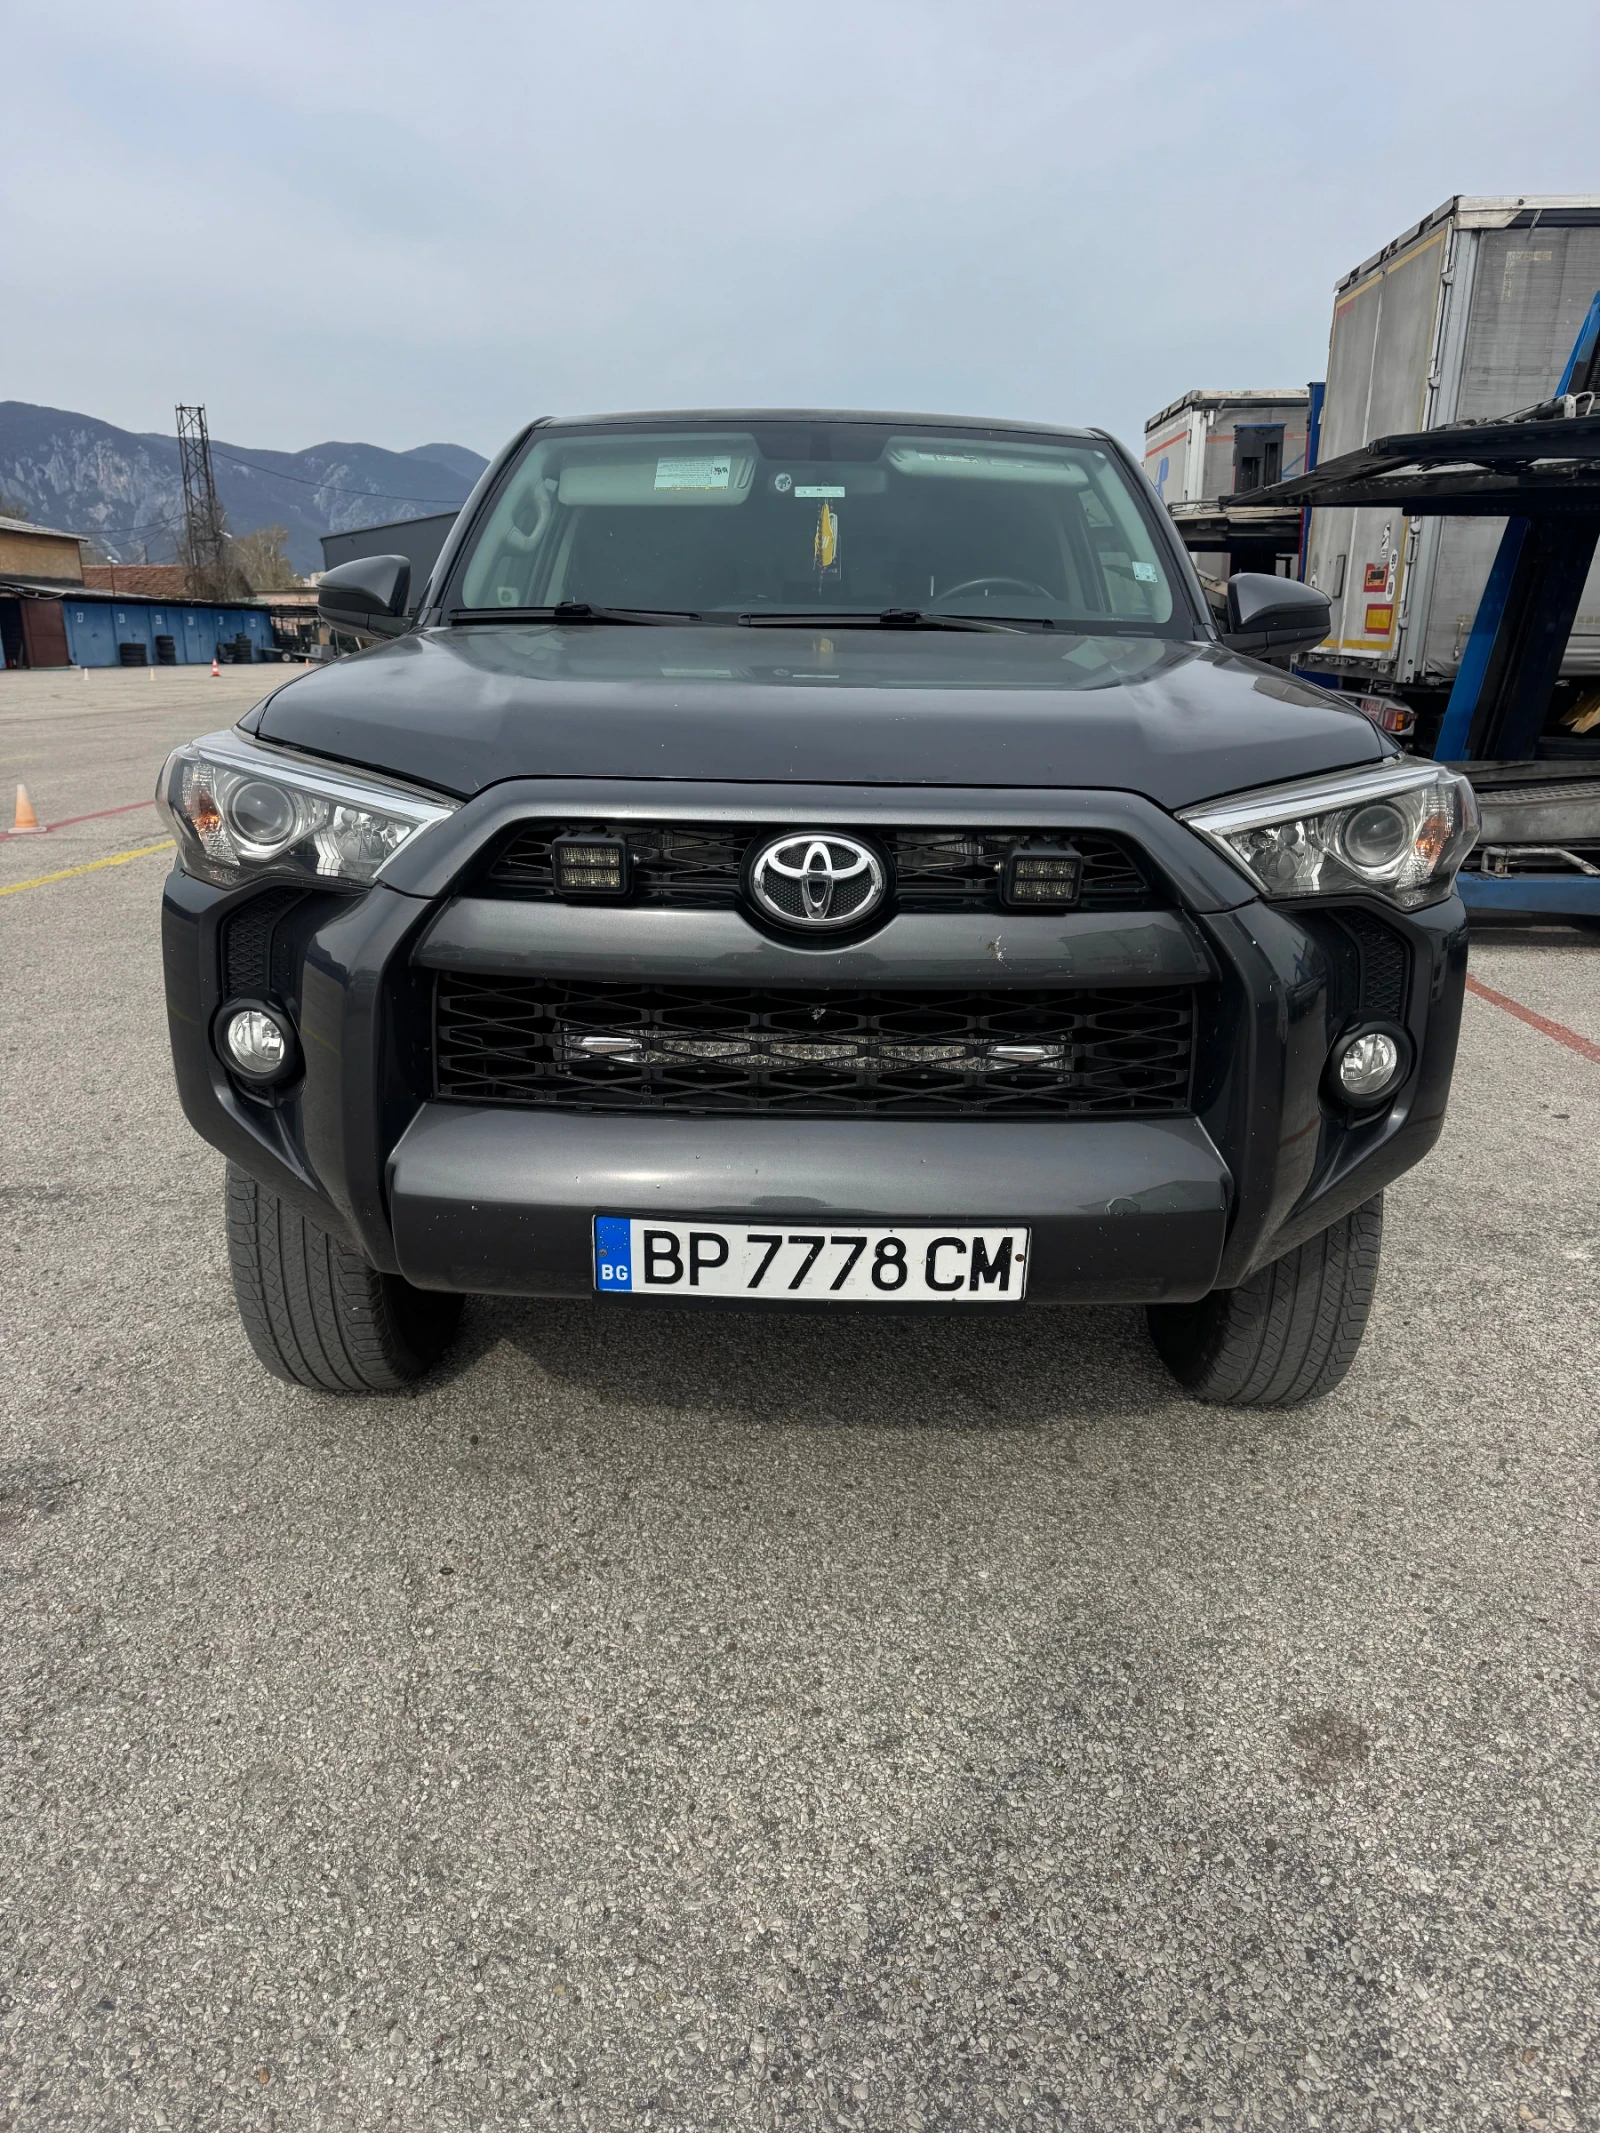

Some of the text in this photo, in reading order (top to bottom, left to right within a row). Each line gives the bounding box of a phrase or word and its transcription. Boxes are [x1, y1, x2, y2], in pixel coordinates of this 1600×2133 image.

[601, 1264, 629, 1281] BG
[643, 1229, 1013, 1291] BP 7778 CM
